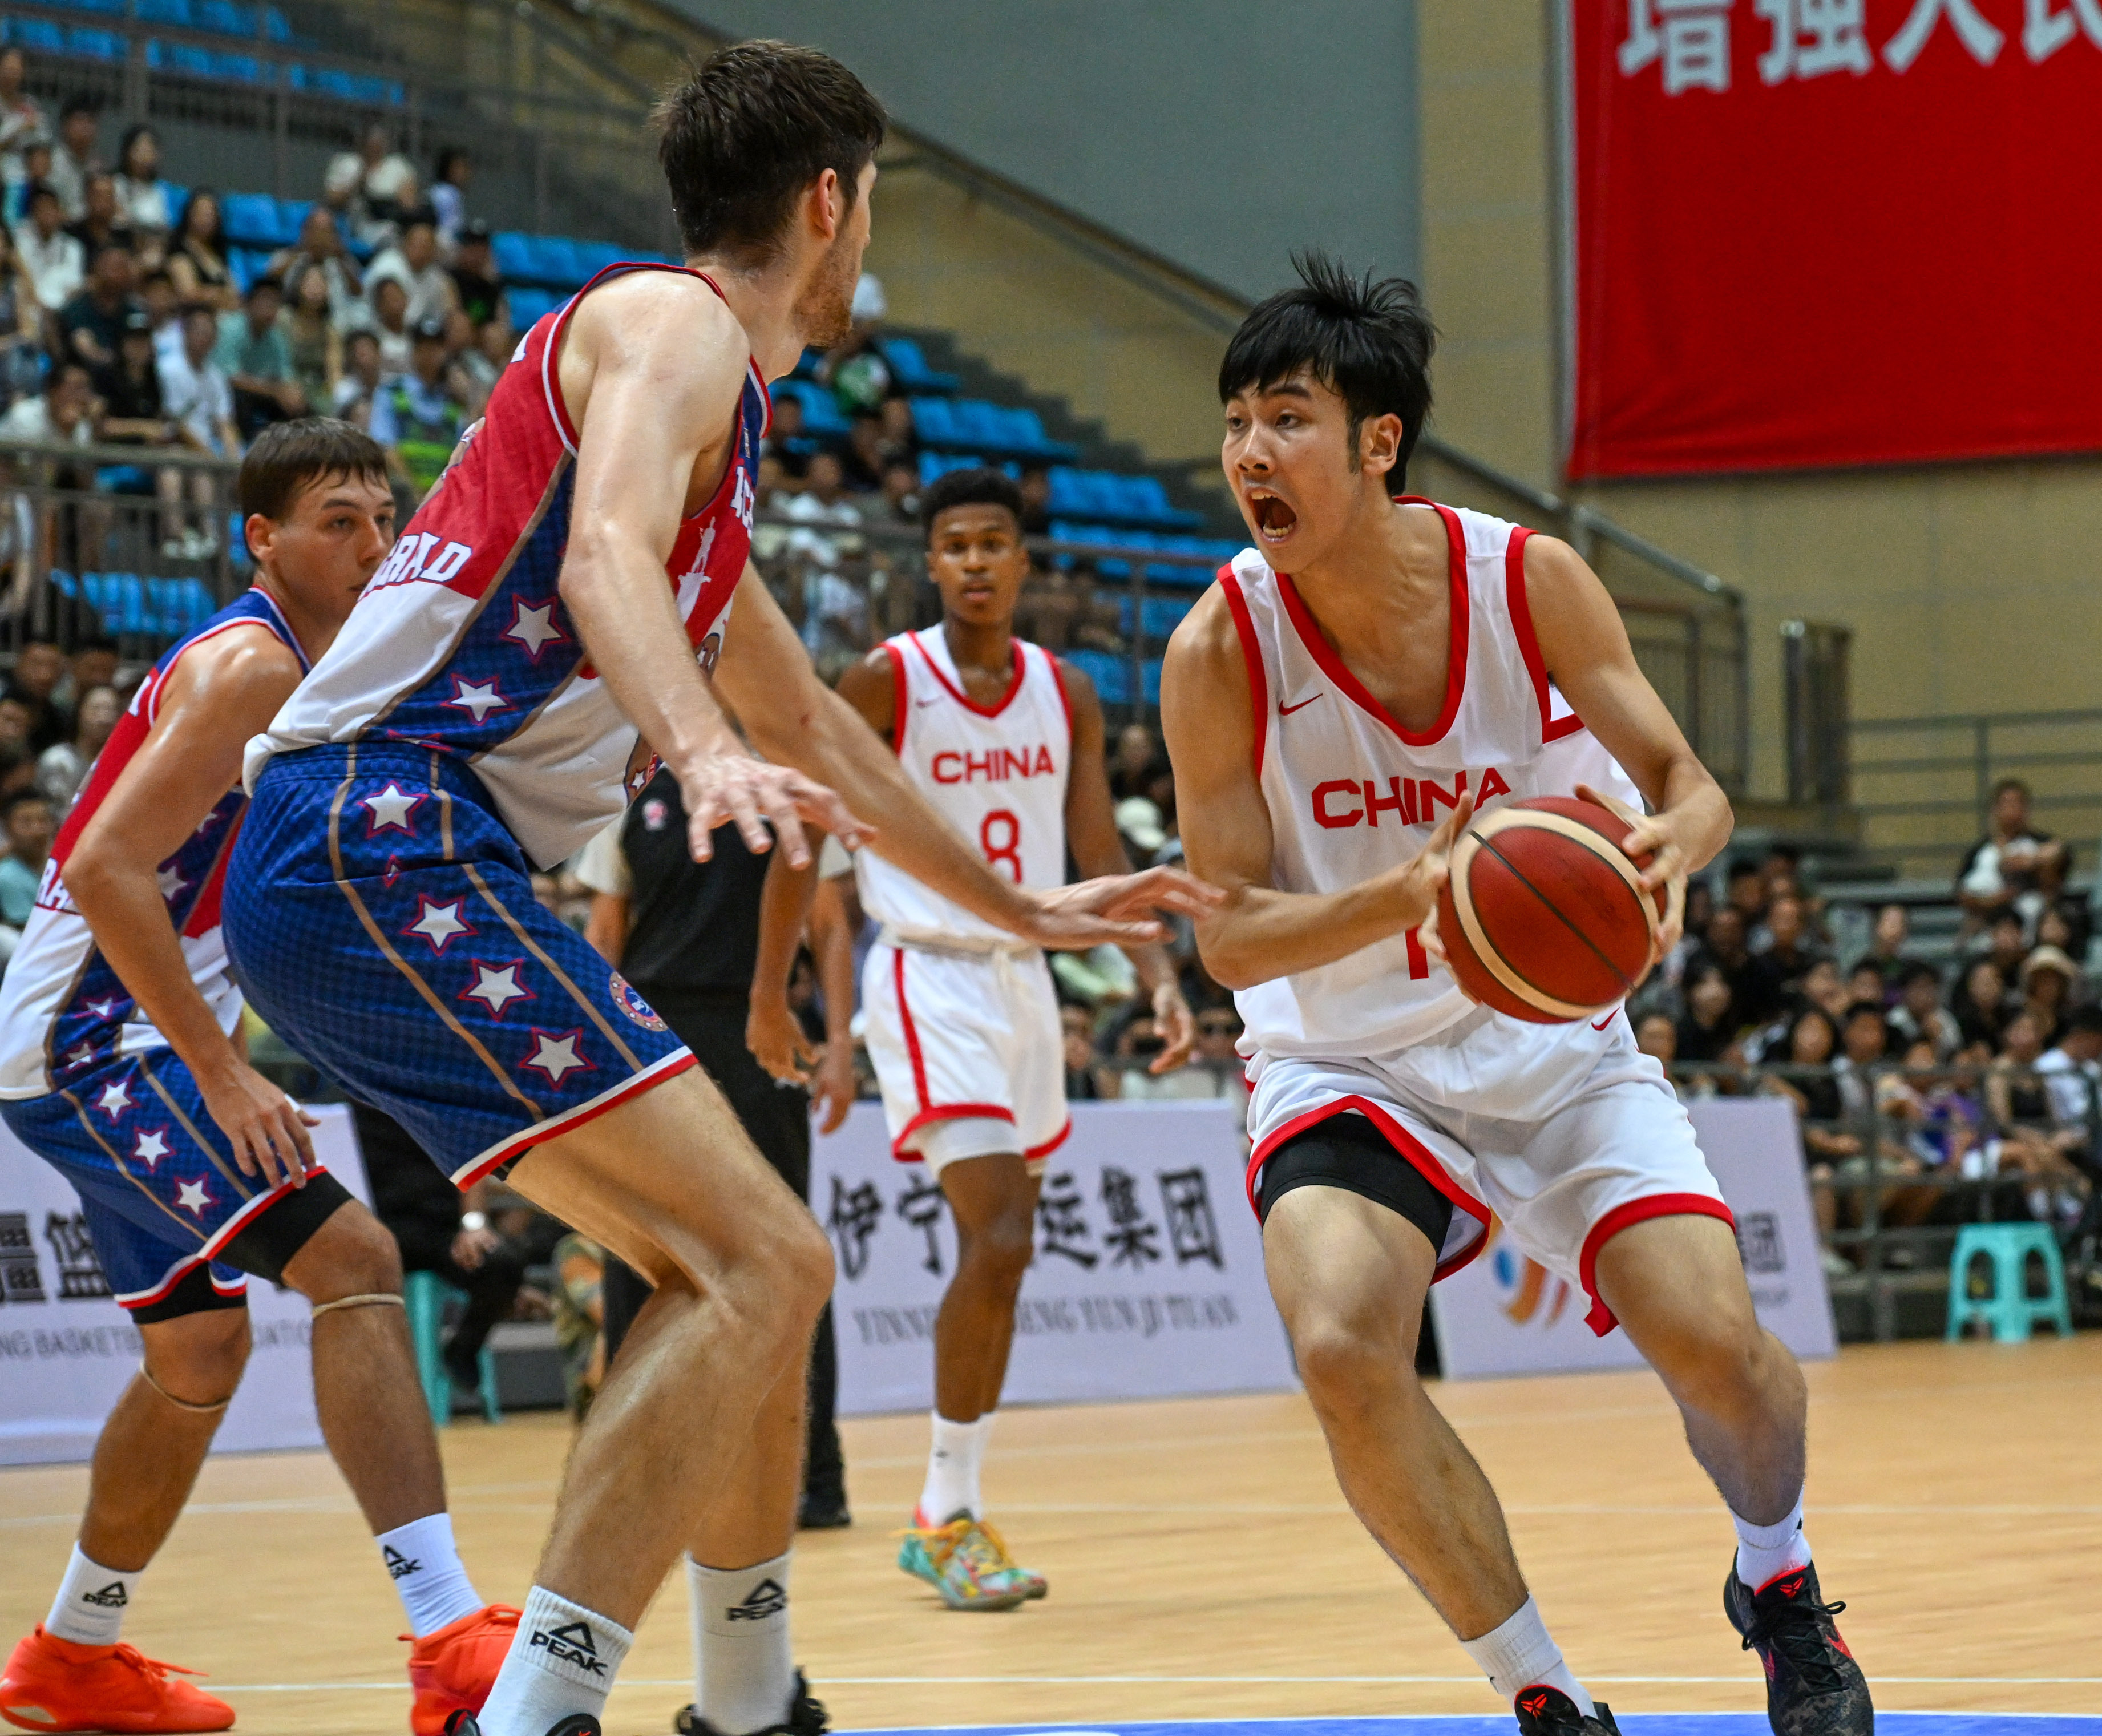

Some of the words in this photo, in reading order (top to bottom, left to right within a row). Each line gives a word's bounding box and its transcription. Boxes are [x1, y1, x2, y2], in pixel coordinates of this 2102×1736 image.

[931, 744, 1056, 784] CHINA
[1312, 767, 1511, 829] CHINA
[826, 1166, 1226, 1283] 伊宁运集团
[529, 1630, 609, 1677] PEAK
